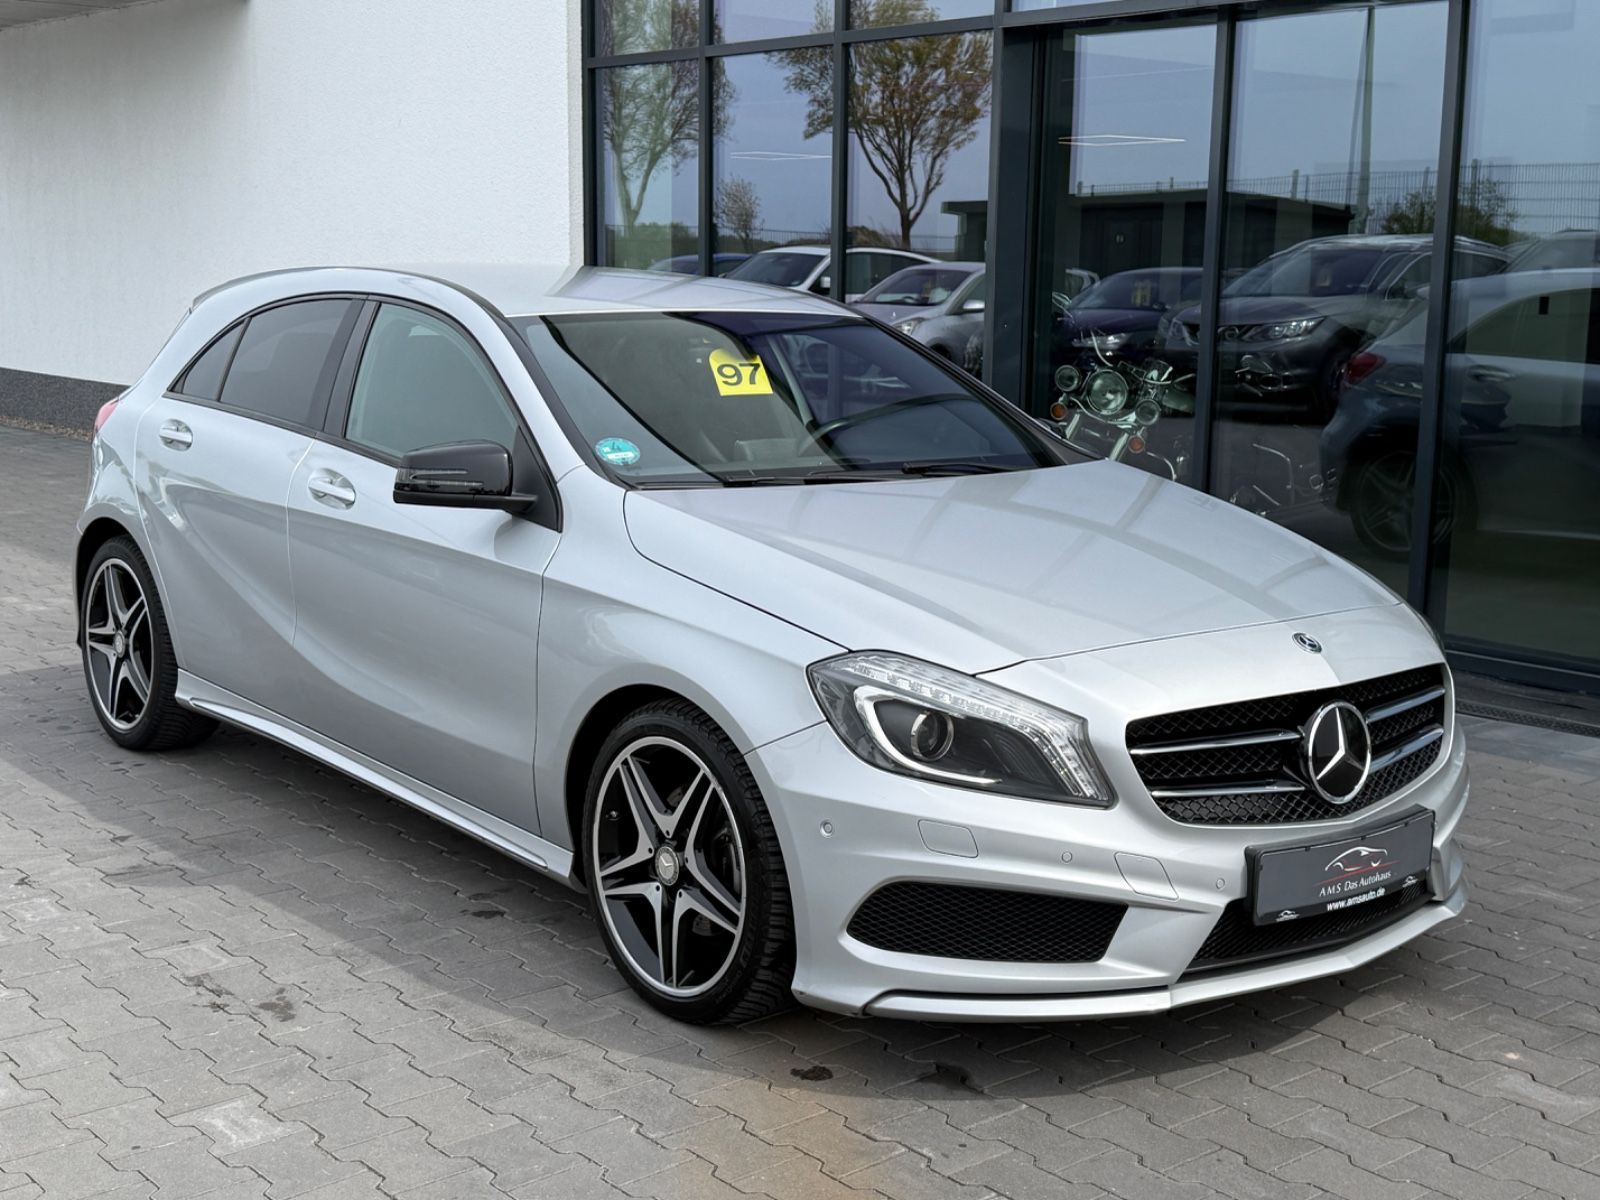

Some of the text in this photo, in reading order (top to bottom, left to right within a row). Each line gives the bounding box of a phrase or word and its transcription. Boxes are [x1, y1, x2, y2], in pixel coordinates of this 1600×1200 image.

[717, 363, 760, 386] 97
[1344, 880, 1358, 891] Das
[1359, 871, 1392, 887] Autohaus
[1327, 887, 1386, 911] www.amsauto.de
